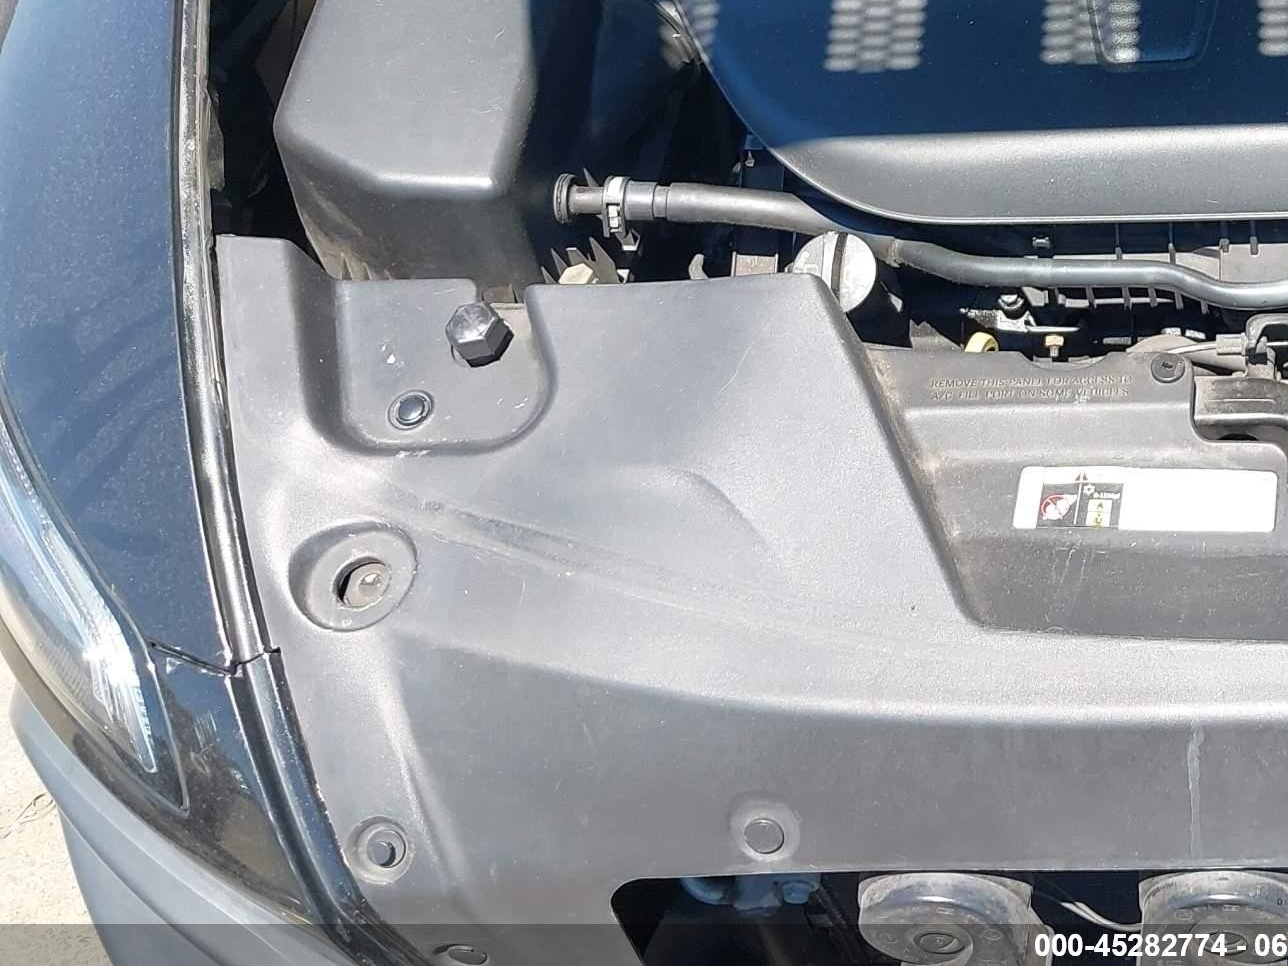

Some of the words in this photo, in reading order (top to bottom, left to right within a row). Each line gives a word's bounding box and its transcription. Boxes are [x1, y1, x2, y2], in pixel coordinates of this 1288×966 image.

[931, 377, 977, 388] REMOVE
[981, 377, 1006, 387] THIS
[1009, 377, 1043, 386] PANEL
[1047, 376, 1070, 386] FOR
[1073, 375, 1115, 385] ACCESS
[933, 391, 953, 400] A/C
[958, 390, 979, 399] FILL
[1039, 388, 1071, 397] SOME
